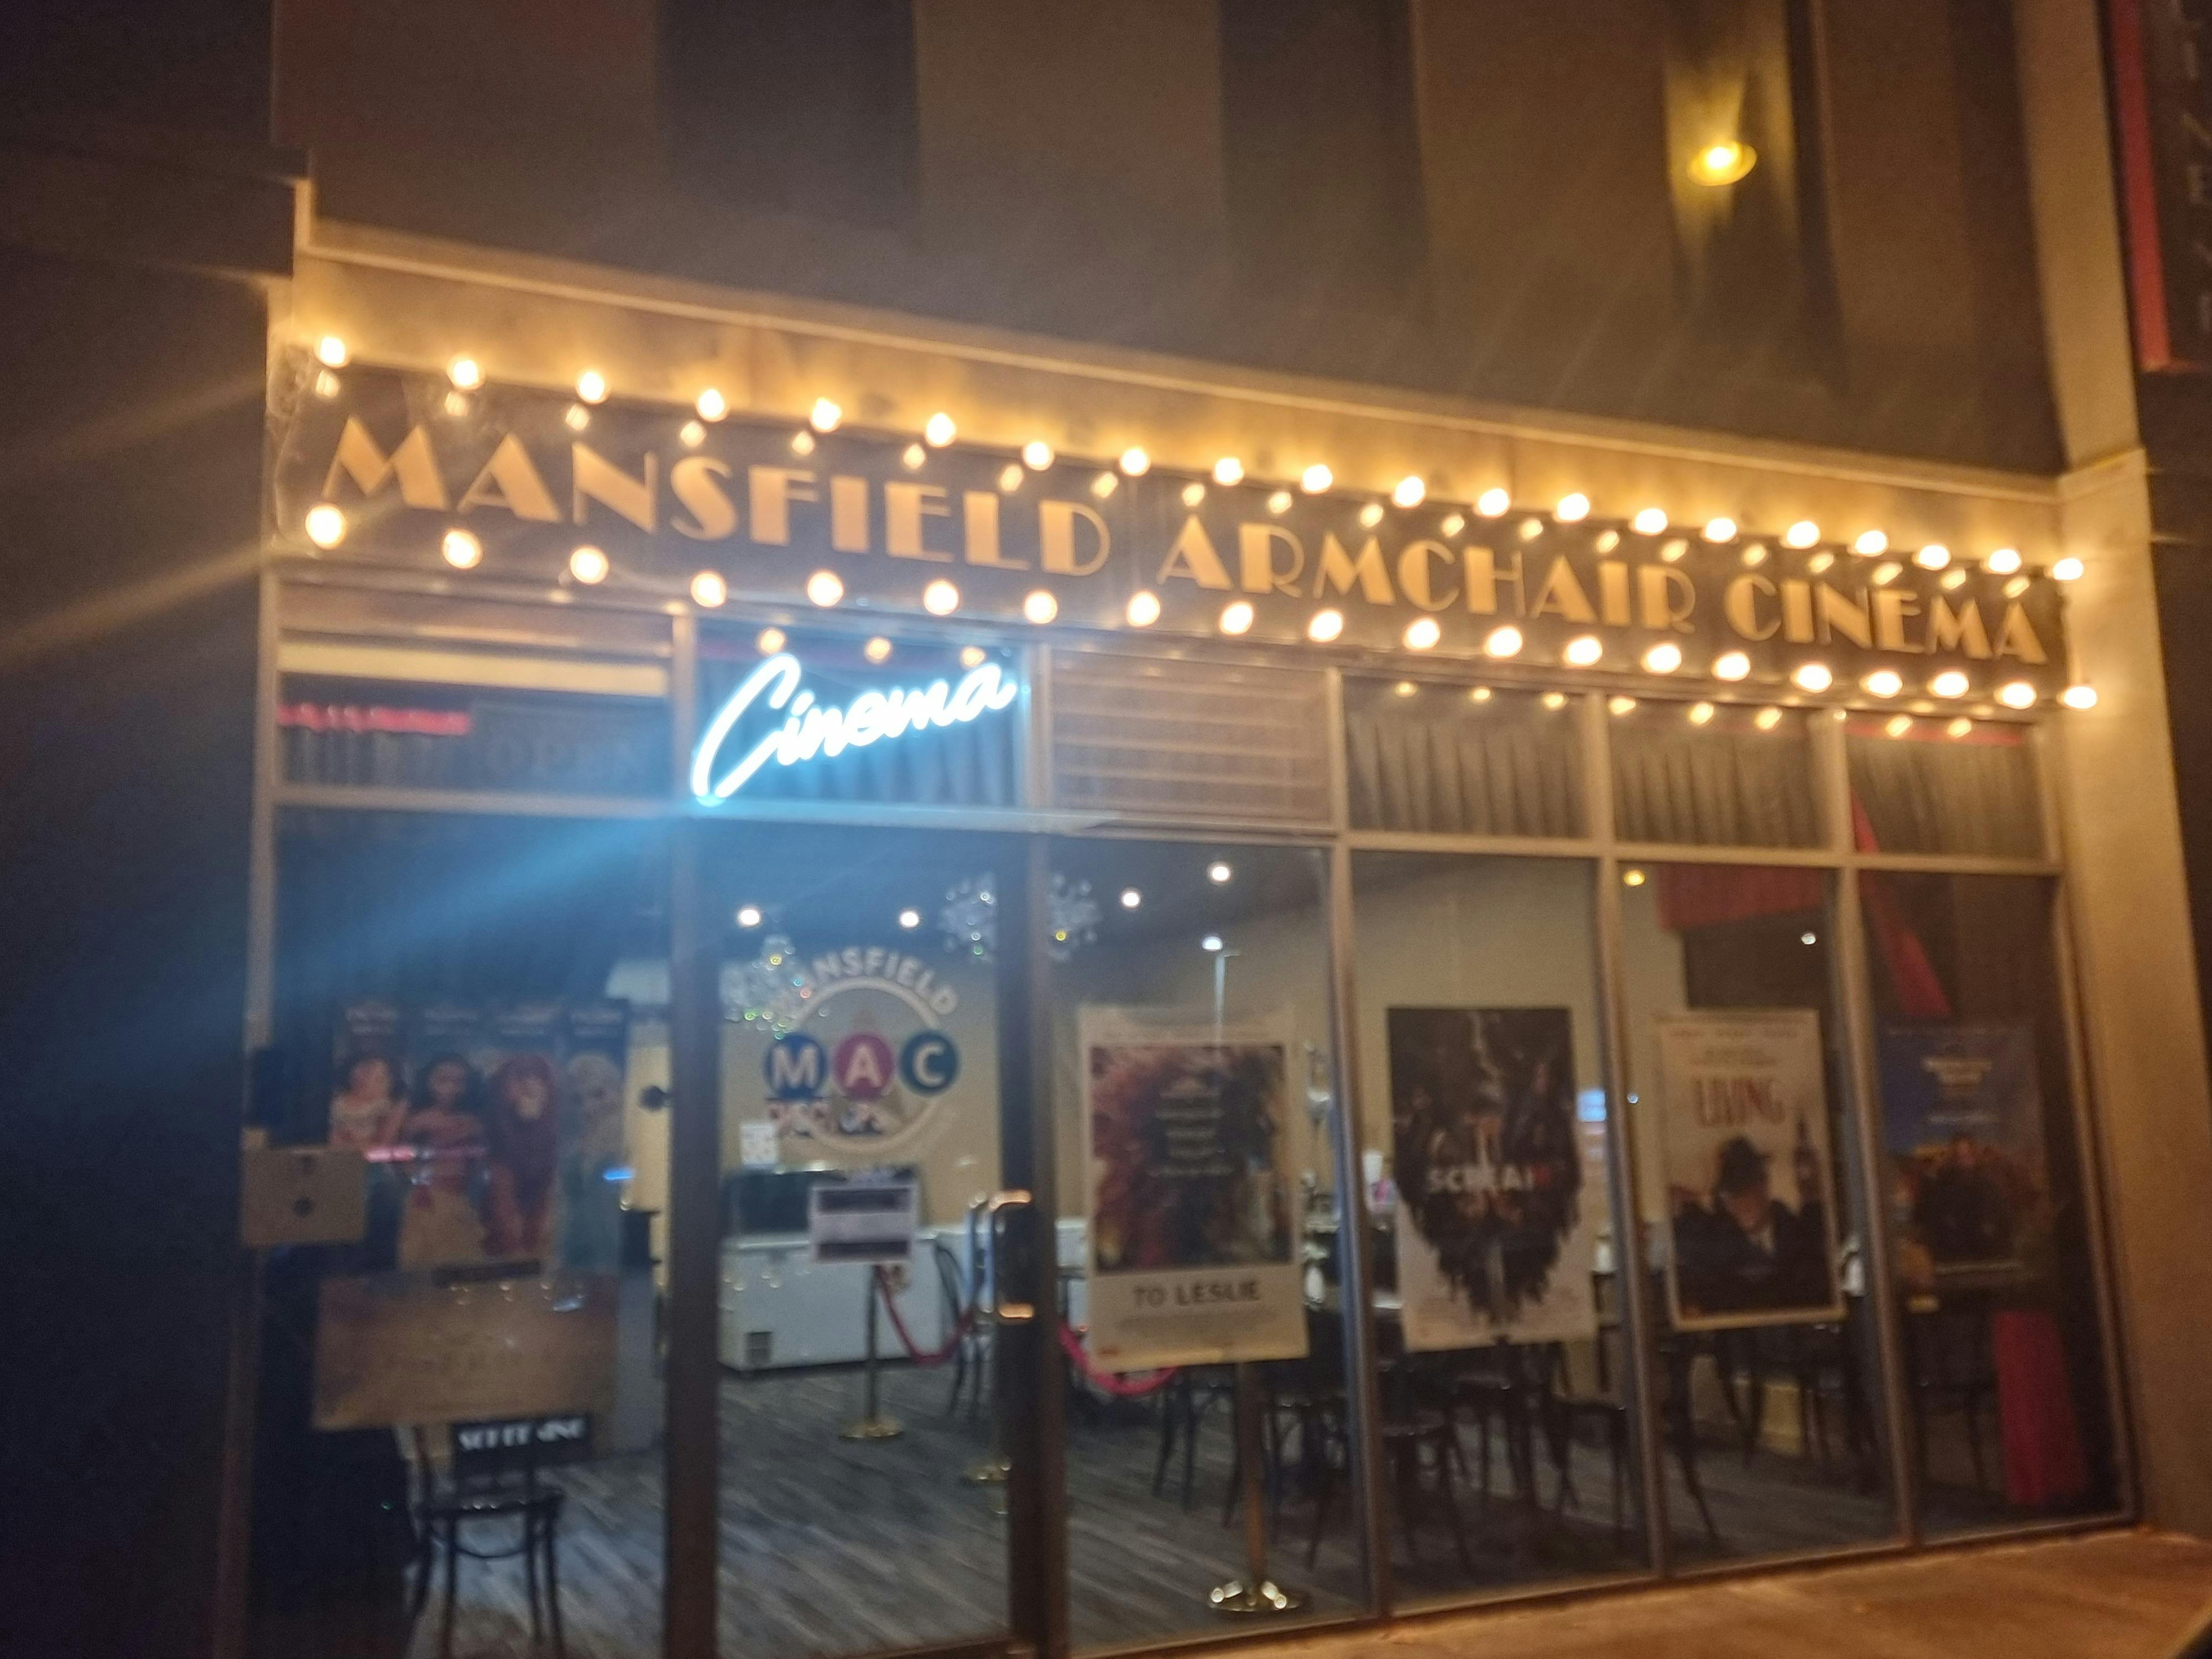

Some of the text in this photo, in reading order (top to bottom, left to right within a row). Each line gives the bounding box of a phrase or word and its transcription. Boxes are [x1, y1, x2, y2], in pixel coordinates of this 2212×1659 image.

[321, 414, 2048, 664] MANSFIELD ARMCHAIR CINEMA
[690, 651, 1019, 802] Cinema
[806, 945, 959, 1015] NSFIELD
[1133, 1284, 1166, 1308] TO
